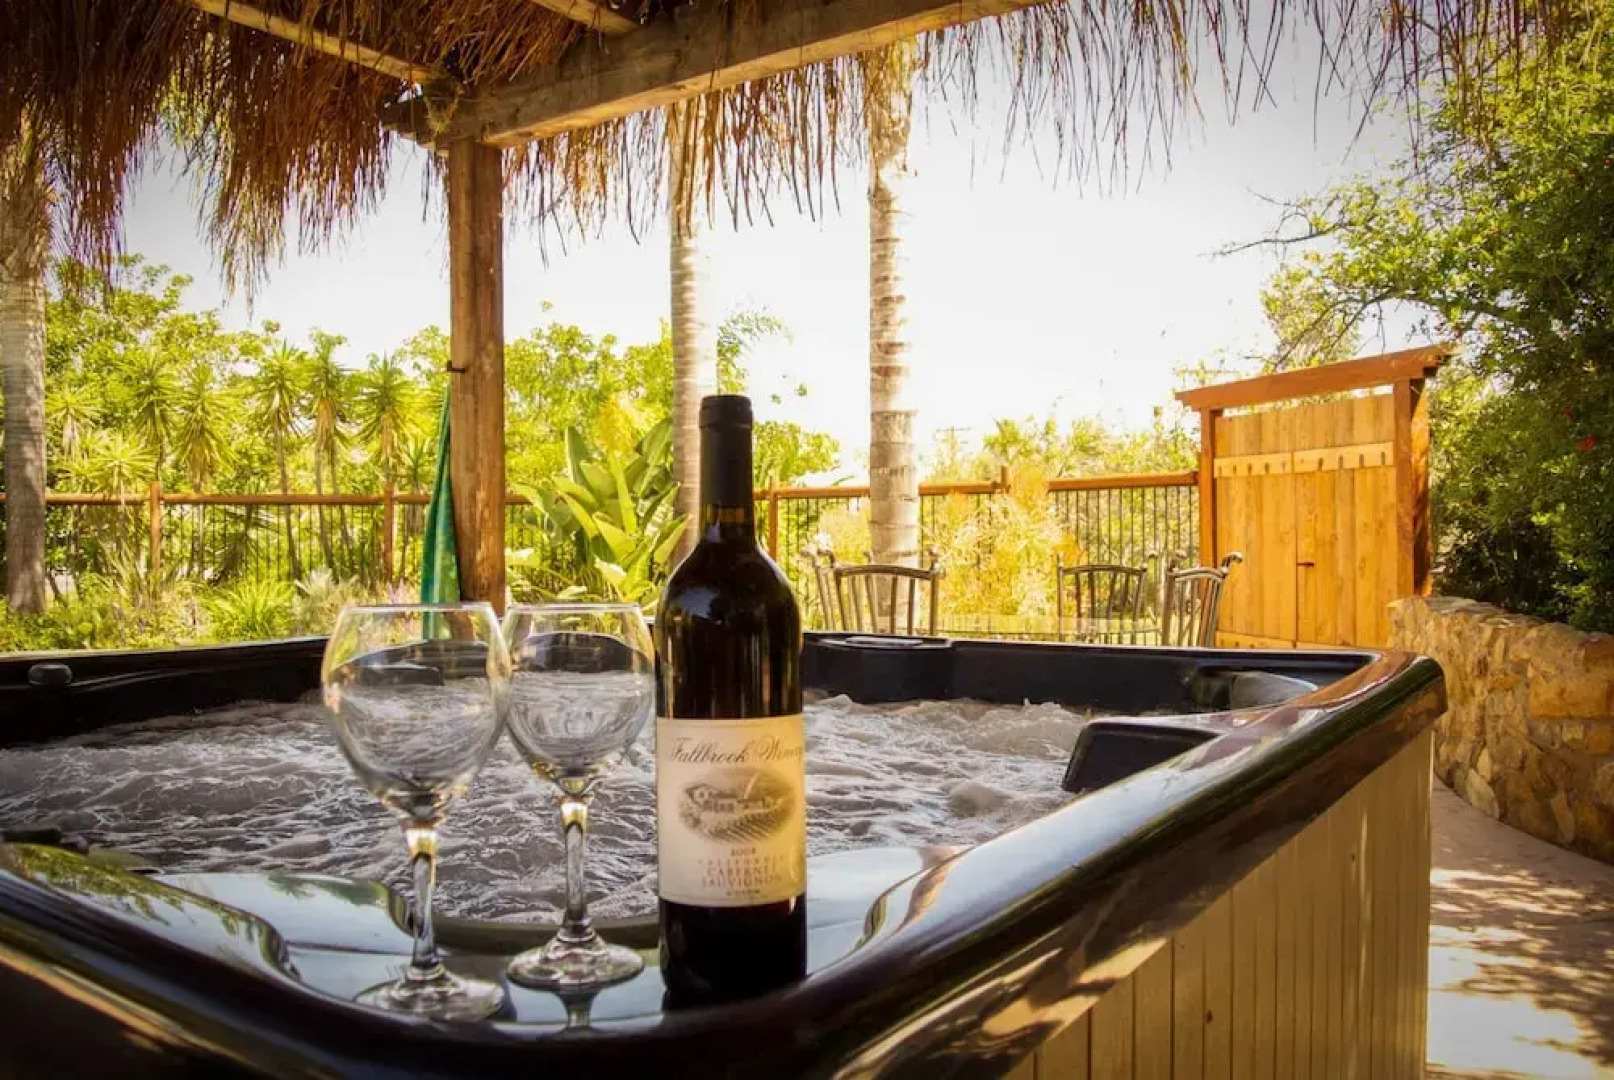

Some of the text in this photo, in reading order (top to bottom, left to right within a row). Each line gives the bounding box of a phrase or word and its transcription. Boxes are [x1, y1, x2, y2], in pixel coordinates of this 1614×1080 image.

[670, 737, 753, 763] Fallbrook
[707, 863, 777, 877] CABERNET
[701, 874, 782, 887] SAUVIGNON
